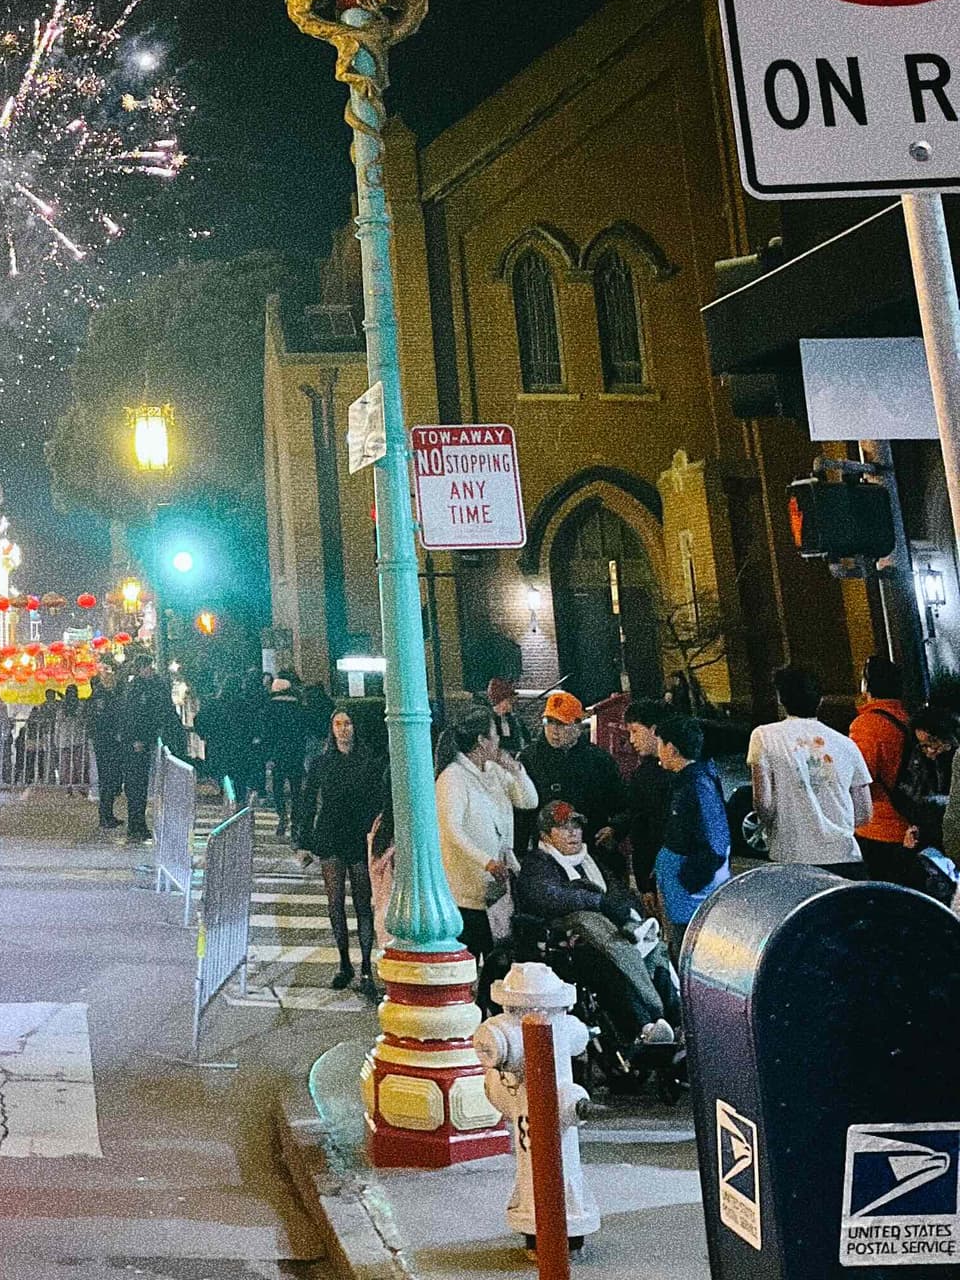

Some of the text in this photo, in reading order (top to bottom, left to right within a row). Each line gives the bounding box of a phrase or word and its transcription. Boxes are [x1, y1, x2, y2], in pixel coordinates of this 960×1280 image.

[763, 56, 868, 130] ON
[418, 429, 505, 445] TOW-AWAY
[416, 447, 511, 475] NO STOPPING
[449, 480, 486, 500] ANY
[448, 503, 493, 525] TIME
[848, 1223, 952, 1240] UNITED STATES
[846, 1239, 957, 1256] POSTAL SERVICE
